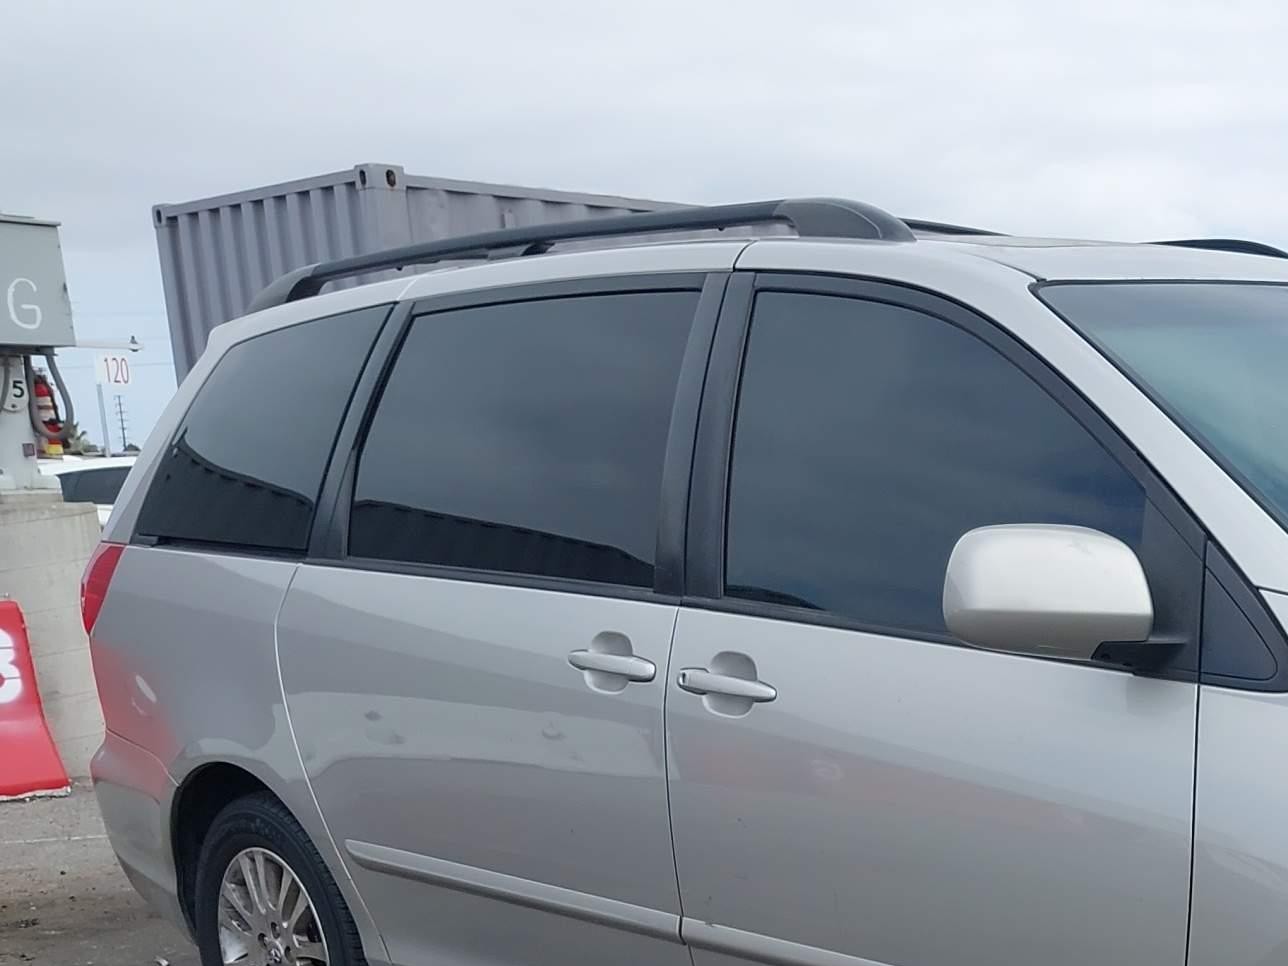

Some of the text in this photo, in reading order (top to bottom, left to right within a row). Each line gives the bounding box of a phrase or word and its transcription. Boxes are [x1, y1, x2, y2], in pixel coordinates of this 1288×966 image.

[8, 278, 42, 330] G
[104, 357, 129, 384] 120
[13, 380, 24, 398] 5
